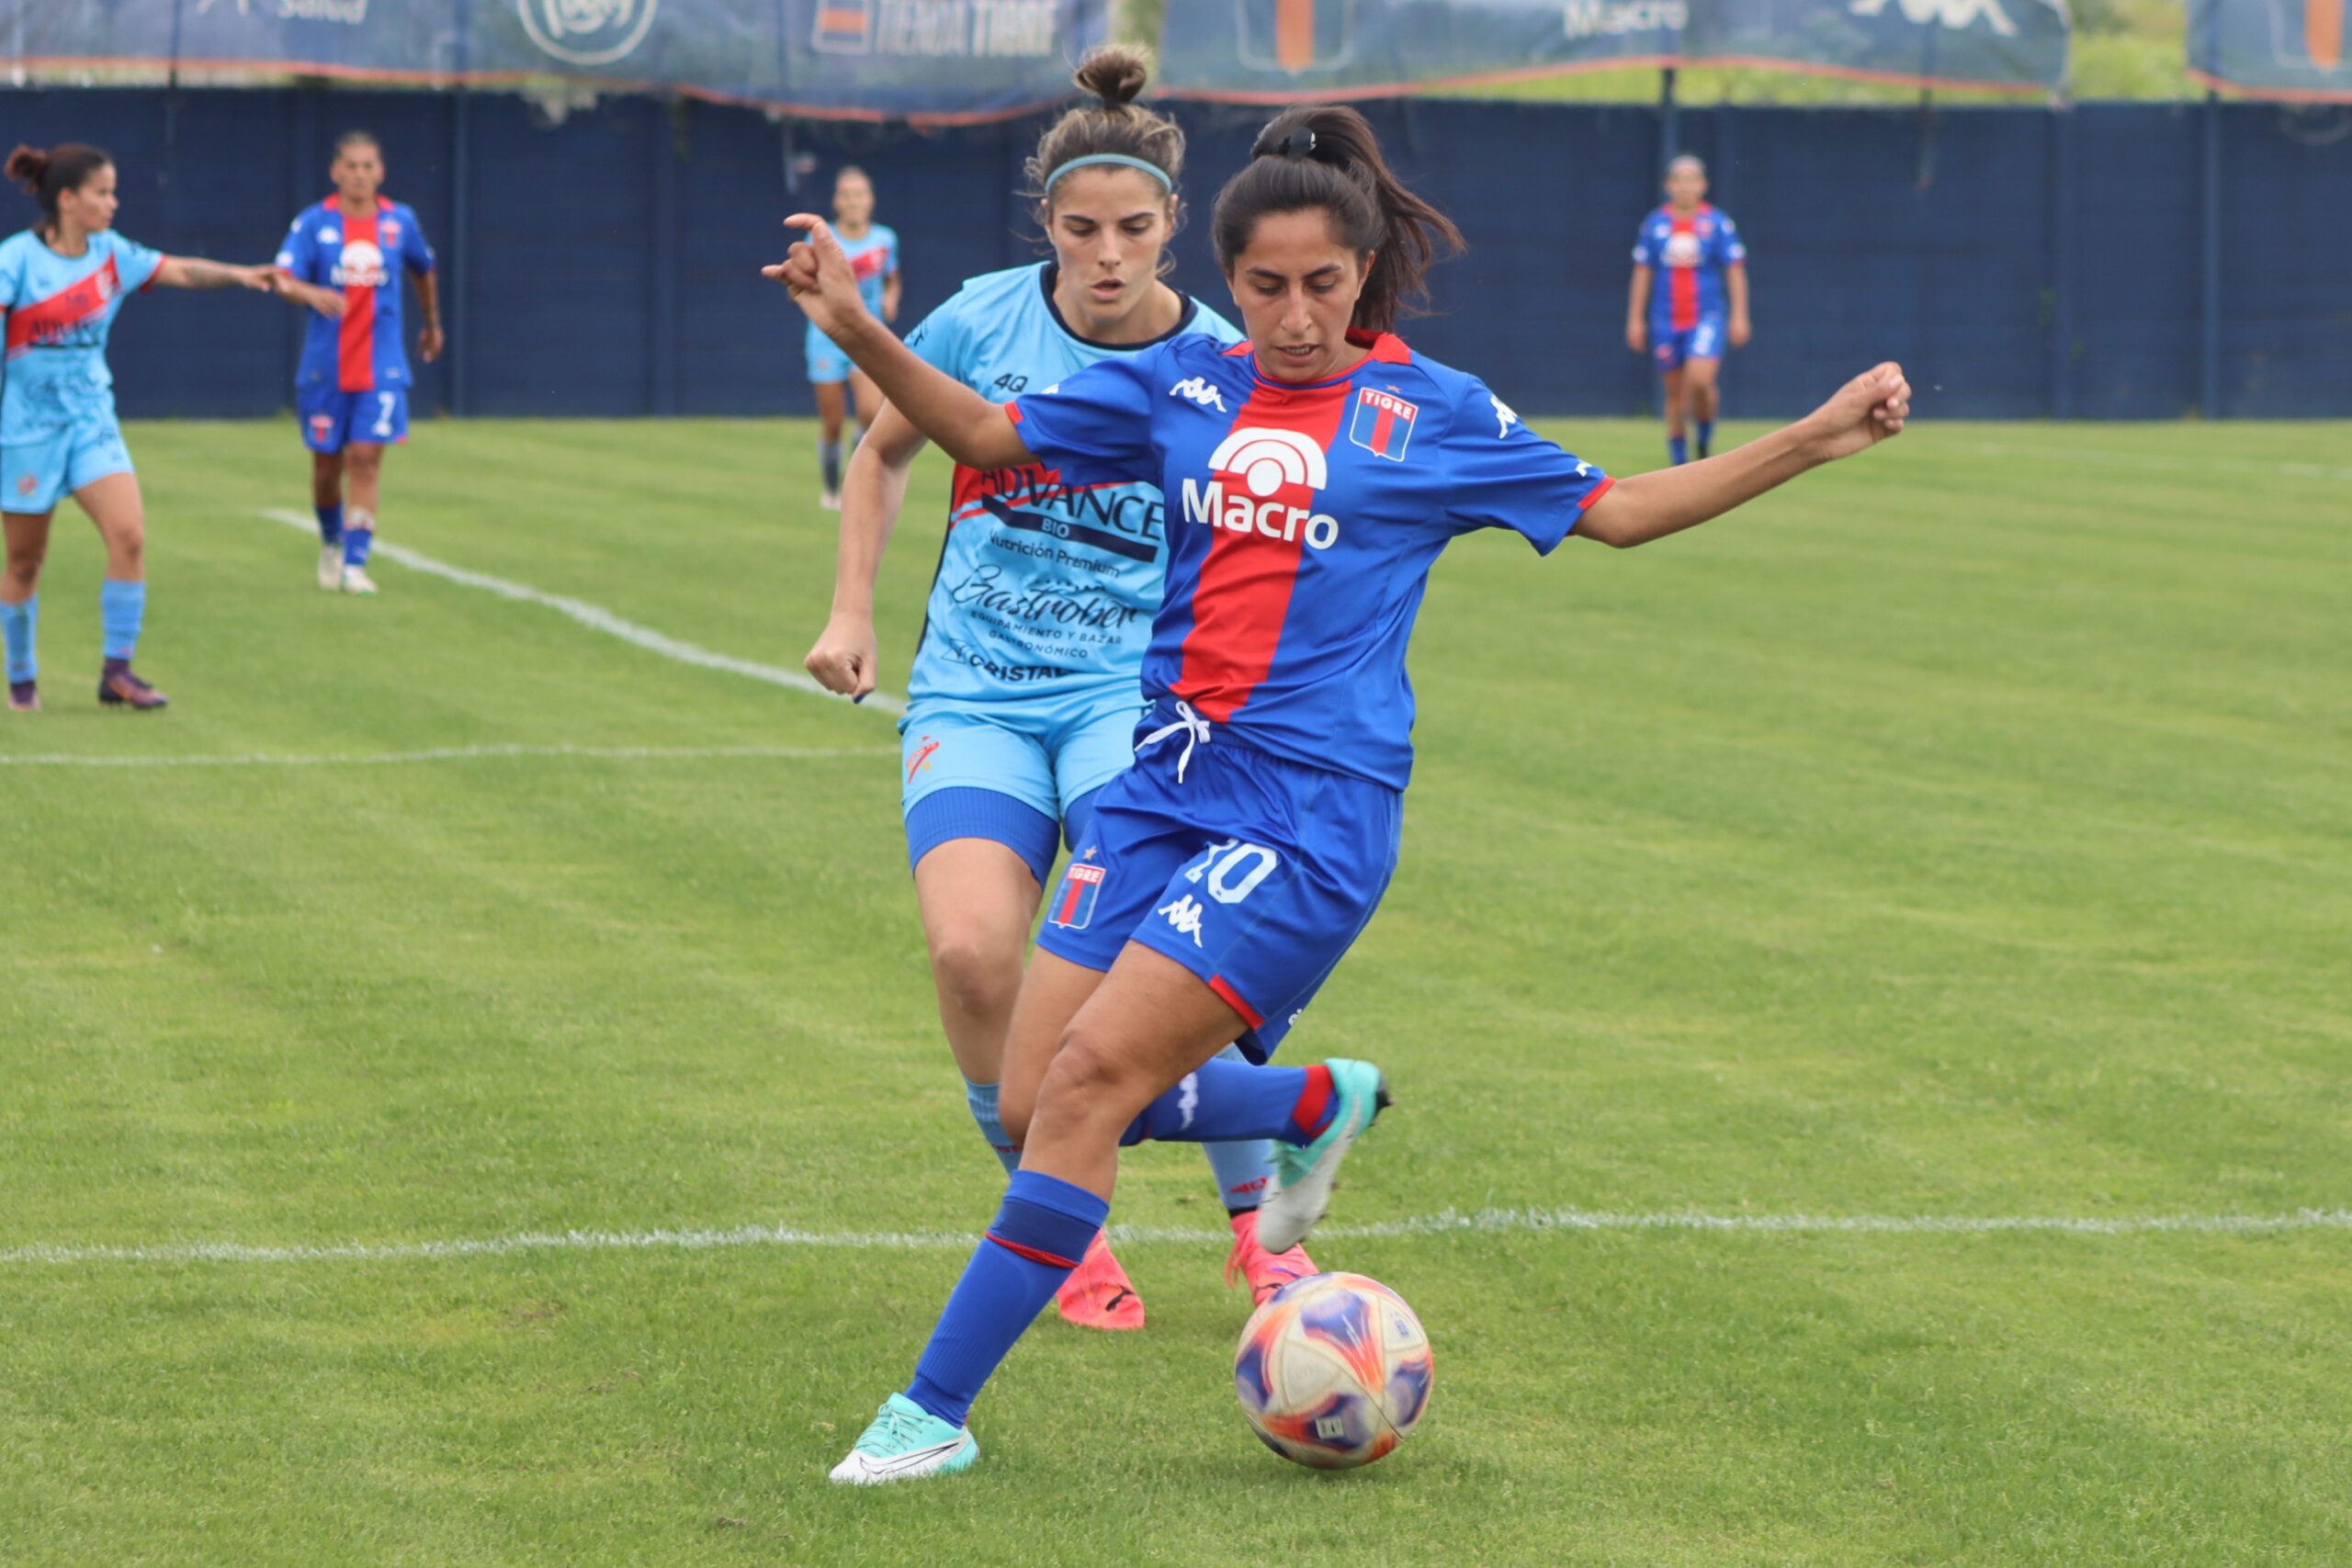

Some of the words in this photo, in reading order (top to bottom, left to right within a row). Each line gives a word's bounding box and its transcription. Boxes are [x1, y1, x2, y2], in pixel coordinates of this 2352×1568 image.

[994, 373, 1029, 393] 4Q
[378, 390, 396, 421] 7
[1363, 390, 1413, 420] TIGRE
[982, 468, 1165, 542] ADVANCE
[1182, 478, 1340, 550] Macro
[1042, 517, 1070, 538] BIO
[989, 529, 1054, 559] Nutrición
[1057, 549, 1120, 579] Premium
[970, 610, 1062, 640] EQUIPAMIENTO
[1067, 630, 1077, 641] Y
[1080, 632, 1122, 647] BAZAR
[989, 628, 1089, 659] GASTRONÓMICO
